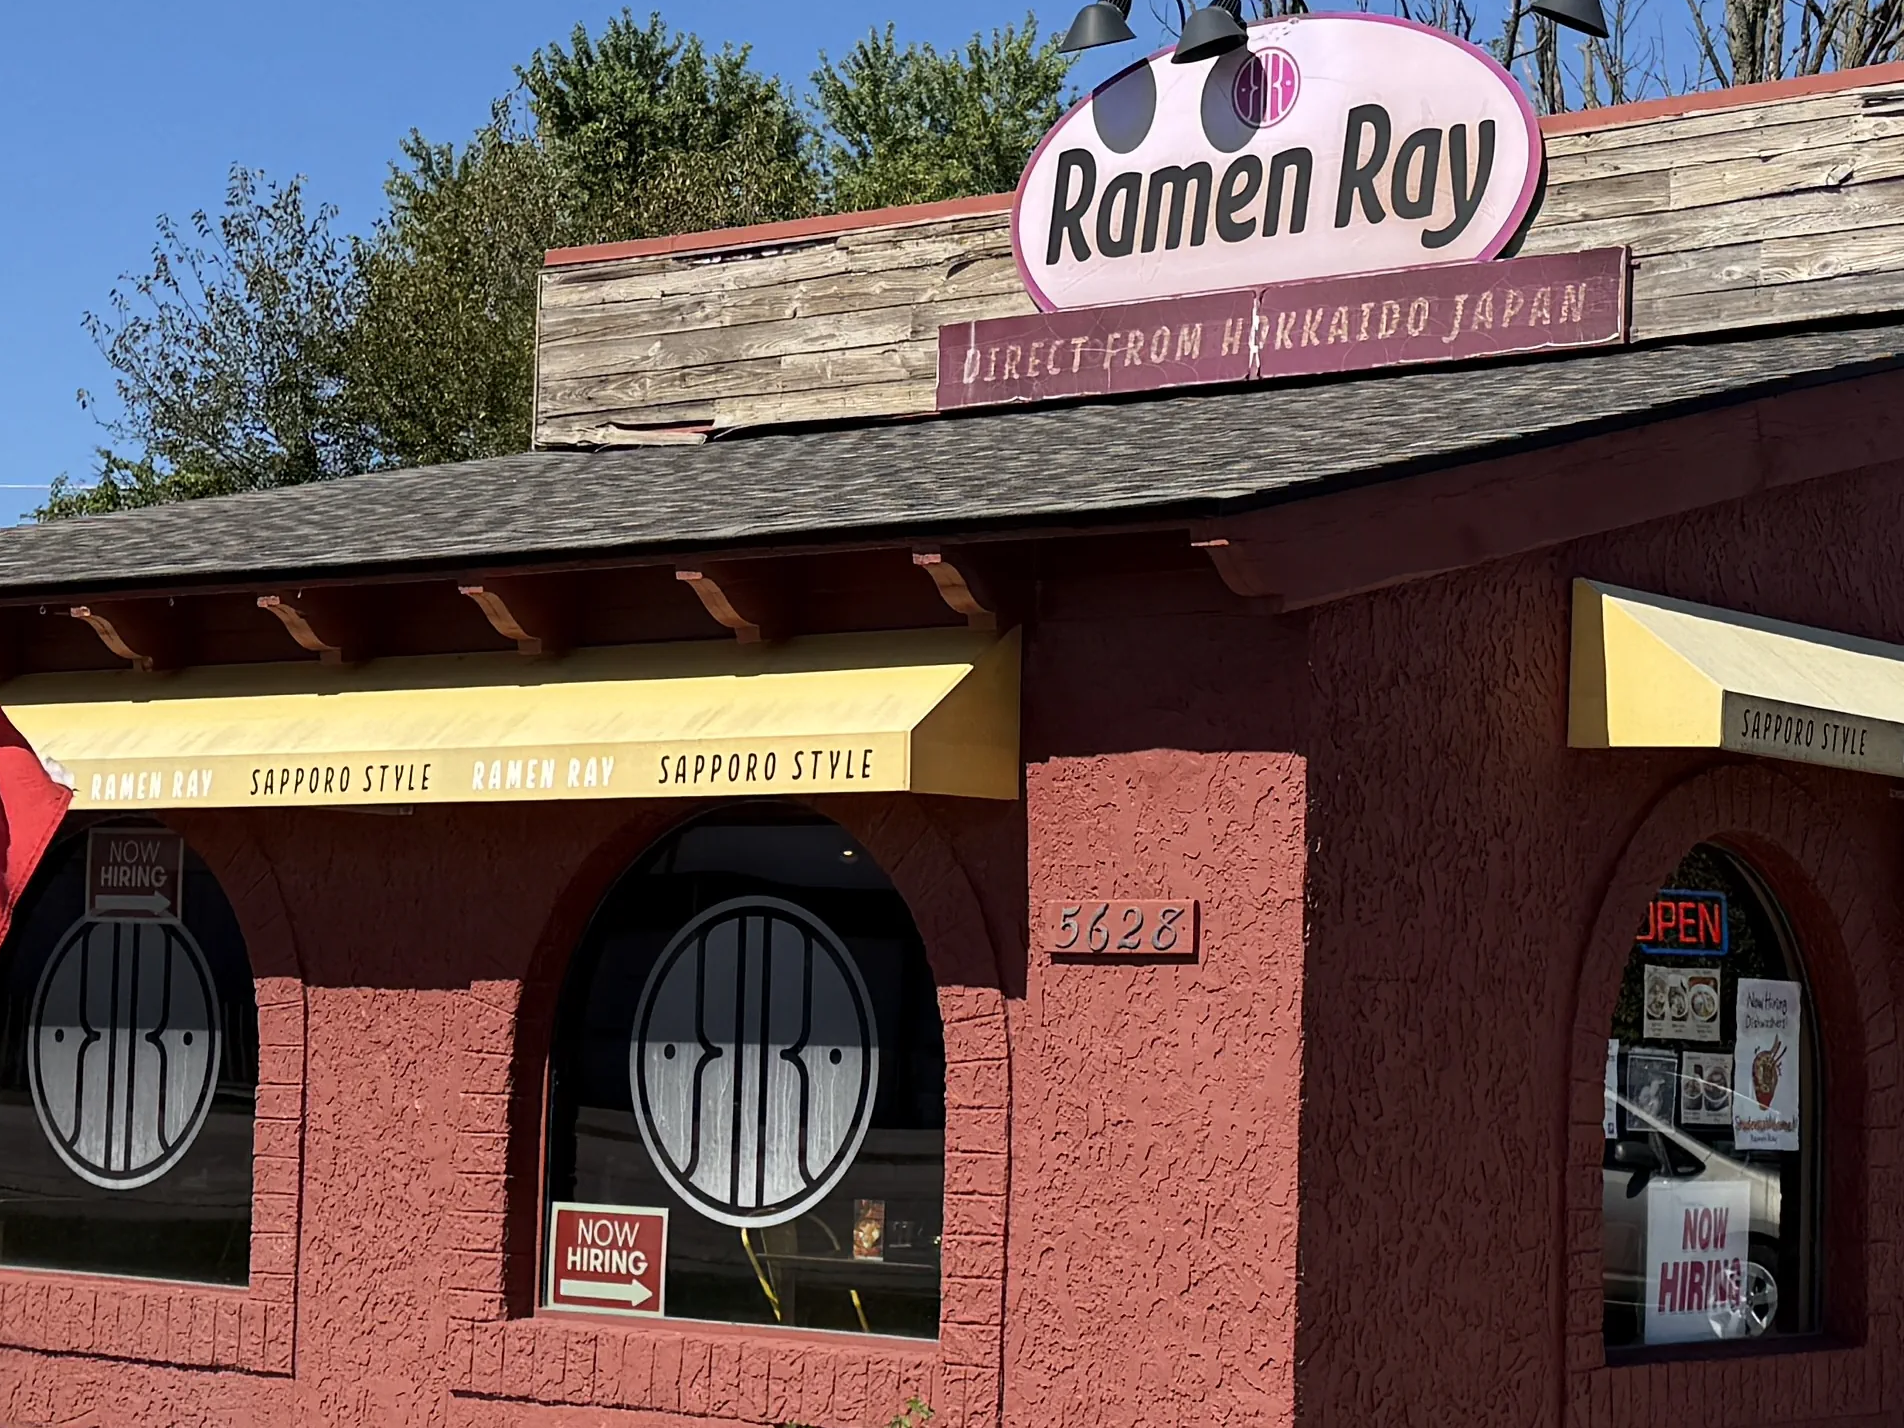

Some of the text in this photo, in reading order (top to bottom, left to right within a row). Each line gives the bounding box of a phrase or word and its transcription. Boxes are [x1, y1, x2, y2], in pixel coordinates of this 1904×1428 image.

[1046, 103, 1496, 266] Ramen Ray
[963, 282, 1587, 384] DIRECT FROM HOKKAIDO JAPAN
[1741, 708, 1814, 748] SAPPORO
[1821, 722, 1867, 756] STYLE
[91, 748, 874, 801] RAMEN RAY SAPPORO STYLE RAMEN RAY SAPPORO STYLE
[109, 839, 161, 864] NOW
[100, 865, 168, 889] HIRING
[1055, 903, 1185, 953] 5628
[1746, 991, 1764, 1010] Now
[577, 1218, 641, 1248] NOW
[1682, 1207, 1729, 1251] NOW
[566, 1246, 649, 1276] HIRING
[1658, 1257, 1742, 1313] HIRING
